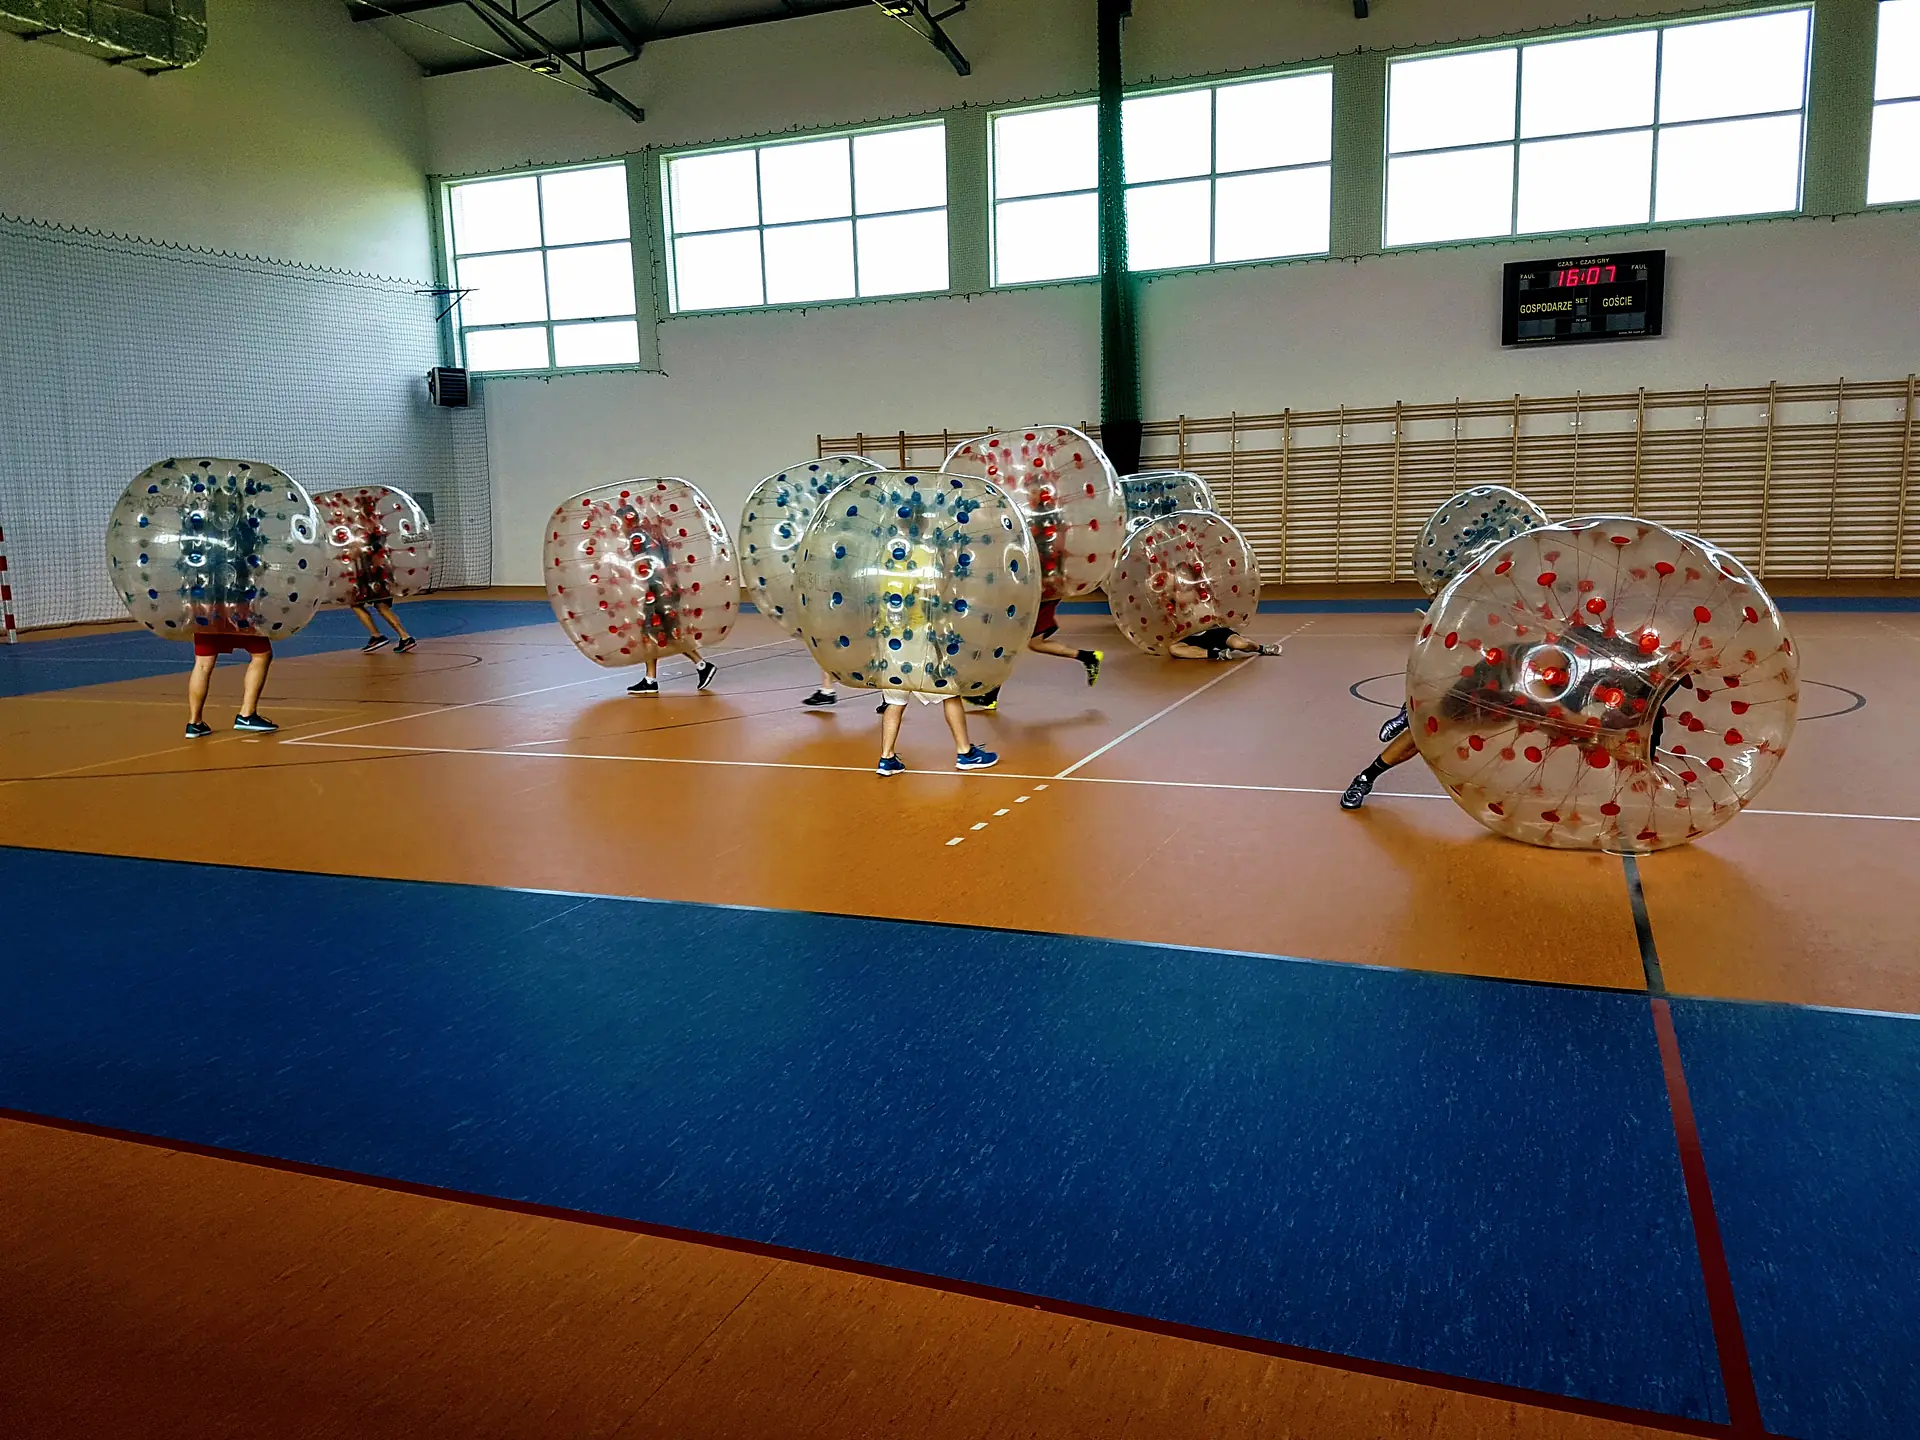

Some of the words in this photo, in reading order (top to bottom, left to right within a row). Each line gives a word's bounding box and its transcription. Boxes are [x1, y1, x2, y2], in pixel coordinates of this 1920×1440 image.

[1558, 265, 1616, 287] 16:07
[1602, 294, 1633, 307] GOŚCIE
[1520, 301, 1573, 314] GOSPODARZE
